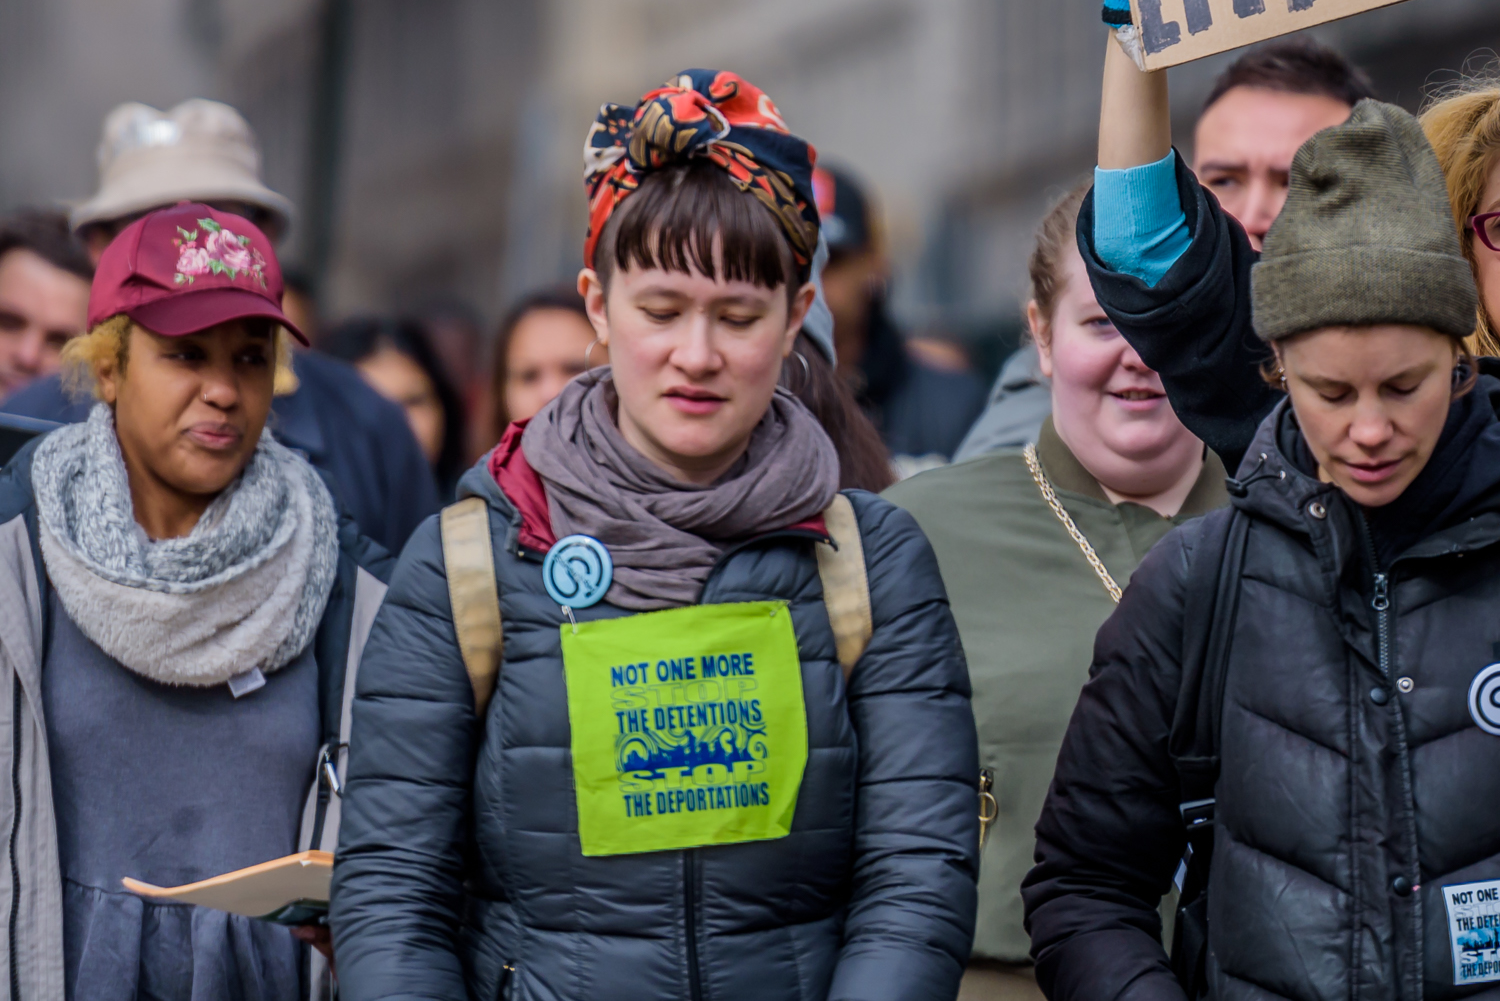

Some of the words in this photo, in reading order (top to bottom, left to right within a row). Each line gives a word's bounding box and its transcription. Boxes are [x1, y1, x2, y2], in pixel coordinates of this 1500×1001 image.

[610, 662, 650, 688] NOT
[656, 657, 697, 682] ONE
[701, 653, 755, 678] MORE
[610, 677, 759, 710] STOP
[615, 709, 649, 734] THE
[653, 699, 763, 731] DETENTIONS
[617, 760, 767, 793] STOP
[623, 793, 653, 817] THE
[656, 782, 770, 815] DEPORTATIONS
[1451, 890, 1473, 905] NOT
[1476, 887, 1499, 902] ONE
[1456, 917, 1475, 931] THE
[1461, 962, 1477, 978] THE
